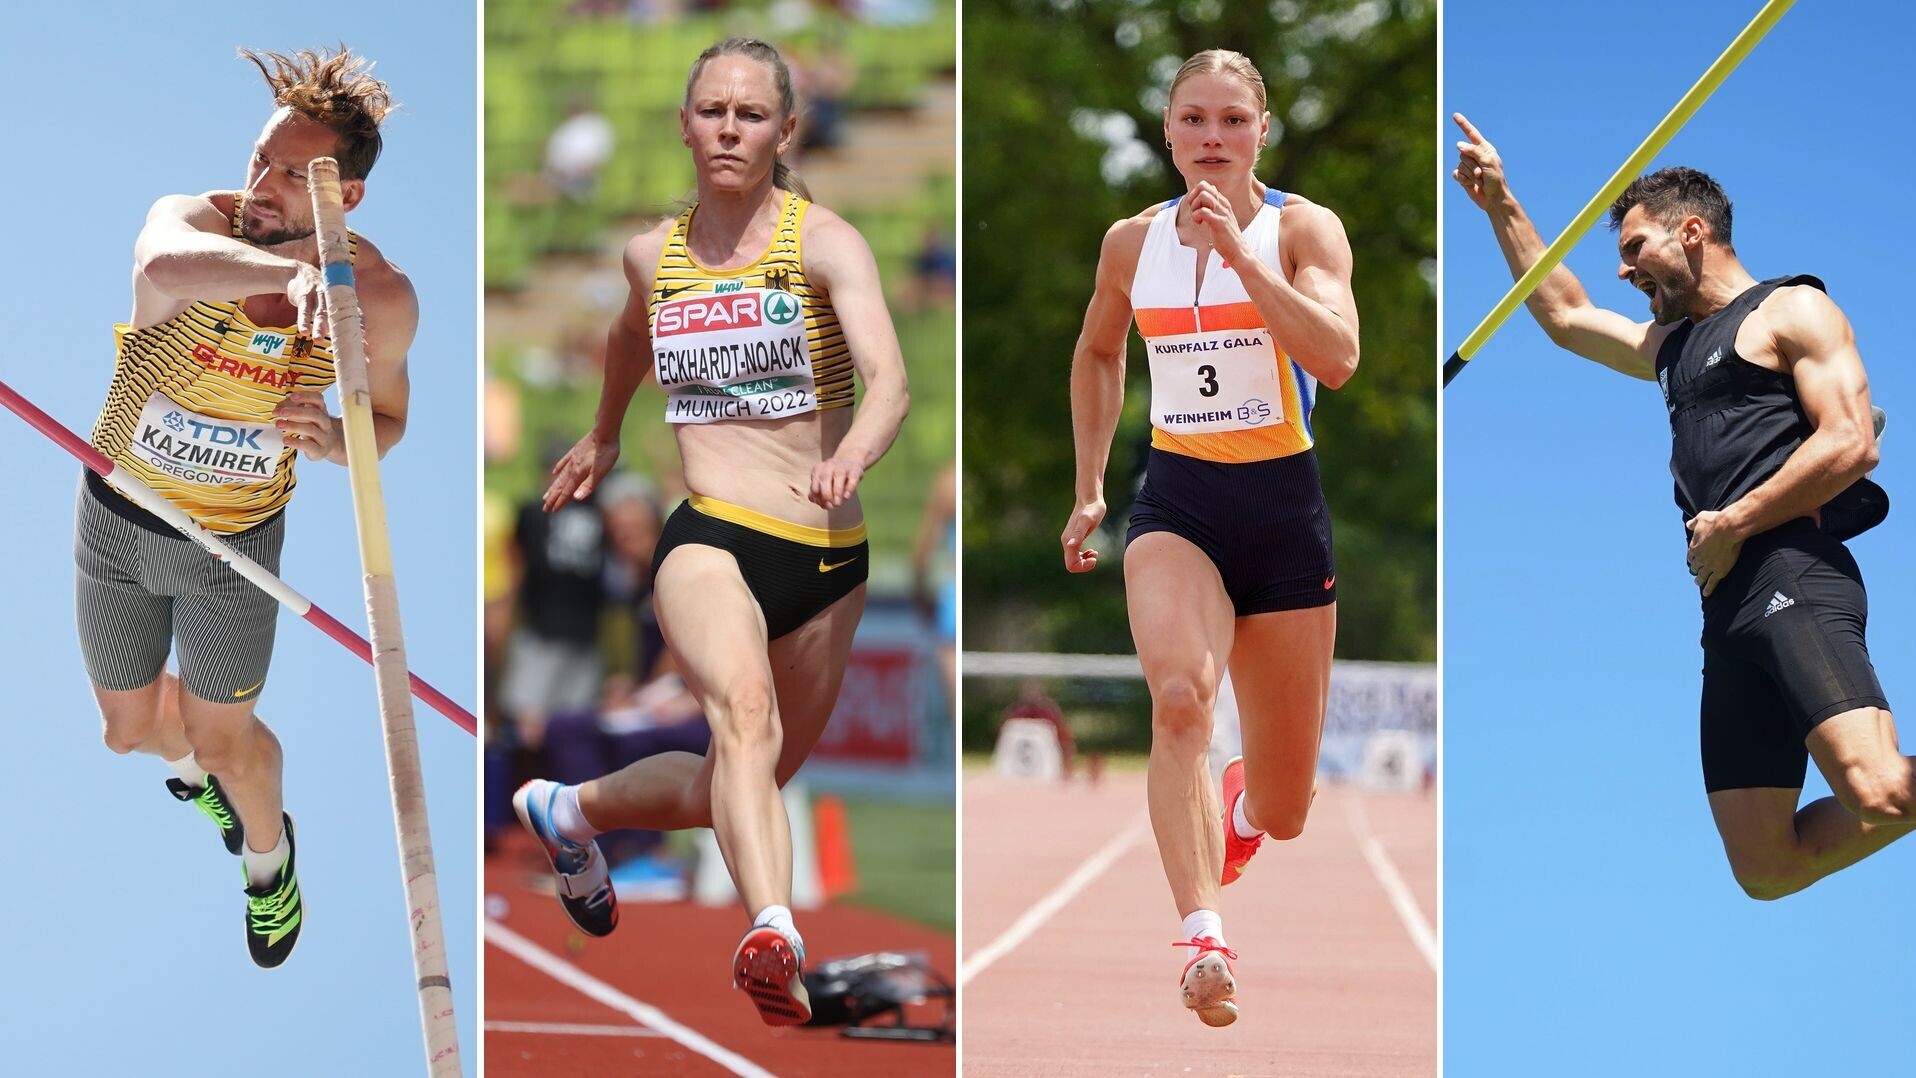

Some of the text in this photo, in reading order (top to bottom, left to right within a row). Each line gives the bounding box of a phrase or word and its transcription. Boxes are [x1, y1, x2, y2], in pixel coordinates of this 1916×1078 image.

[659, 297, 758, 332] SPAR
[657, 335, 806, 386] ECKHARDT-NOACK
[1154, 337, 1263, 354] KURPFALZ GALA
[1197, 364, 1219, 397] 3
[675, 389, 809, 418] MUNICH 2022
[1163, 402, 1271, 425] WEINHEIM B&S
[141, 424, 274, 475] KAZMIREK
[186, 418, 265, 450] TDK
[1764, 598, 1795, 618] adidas
